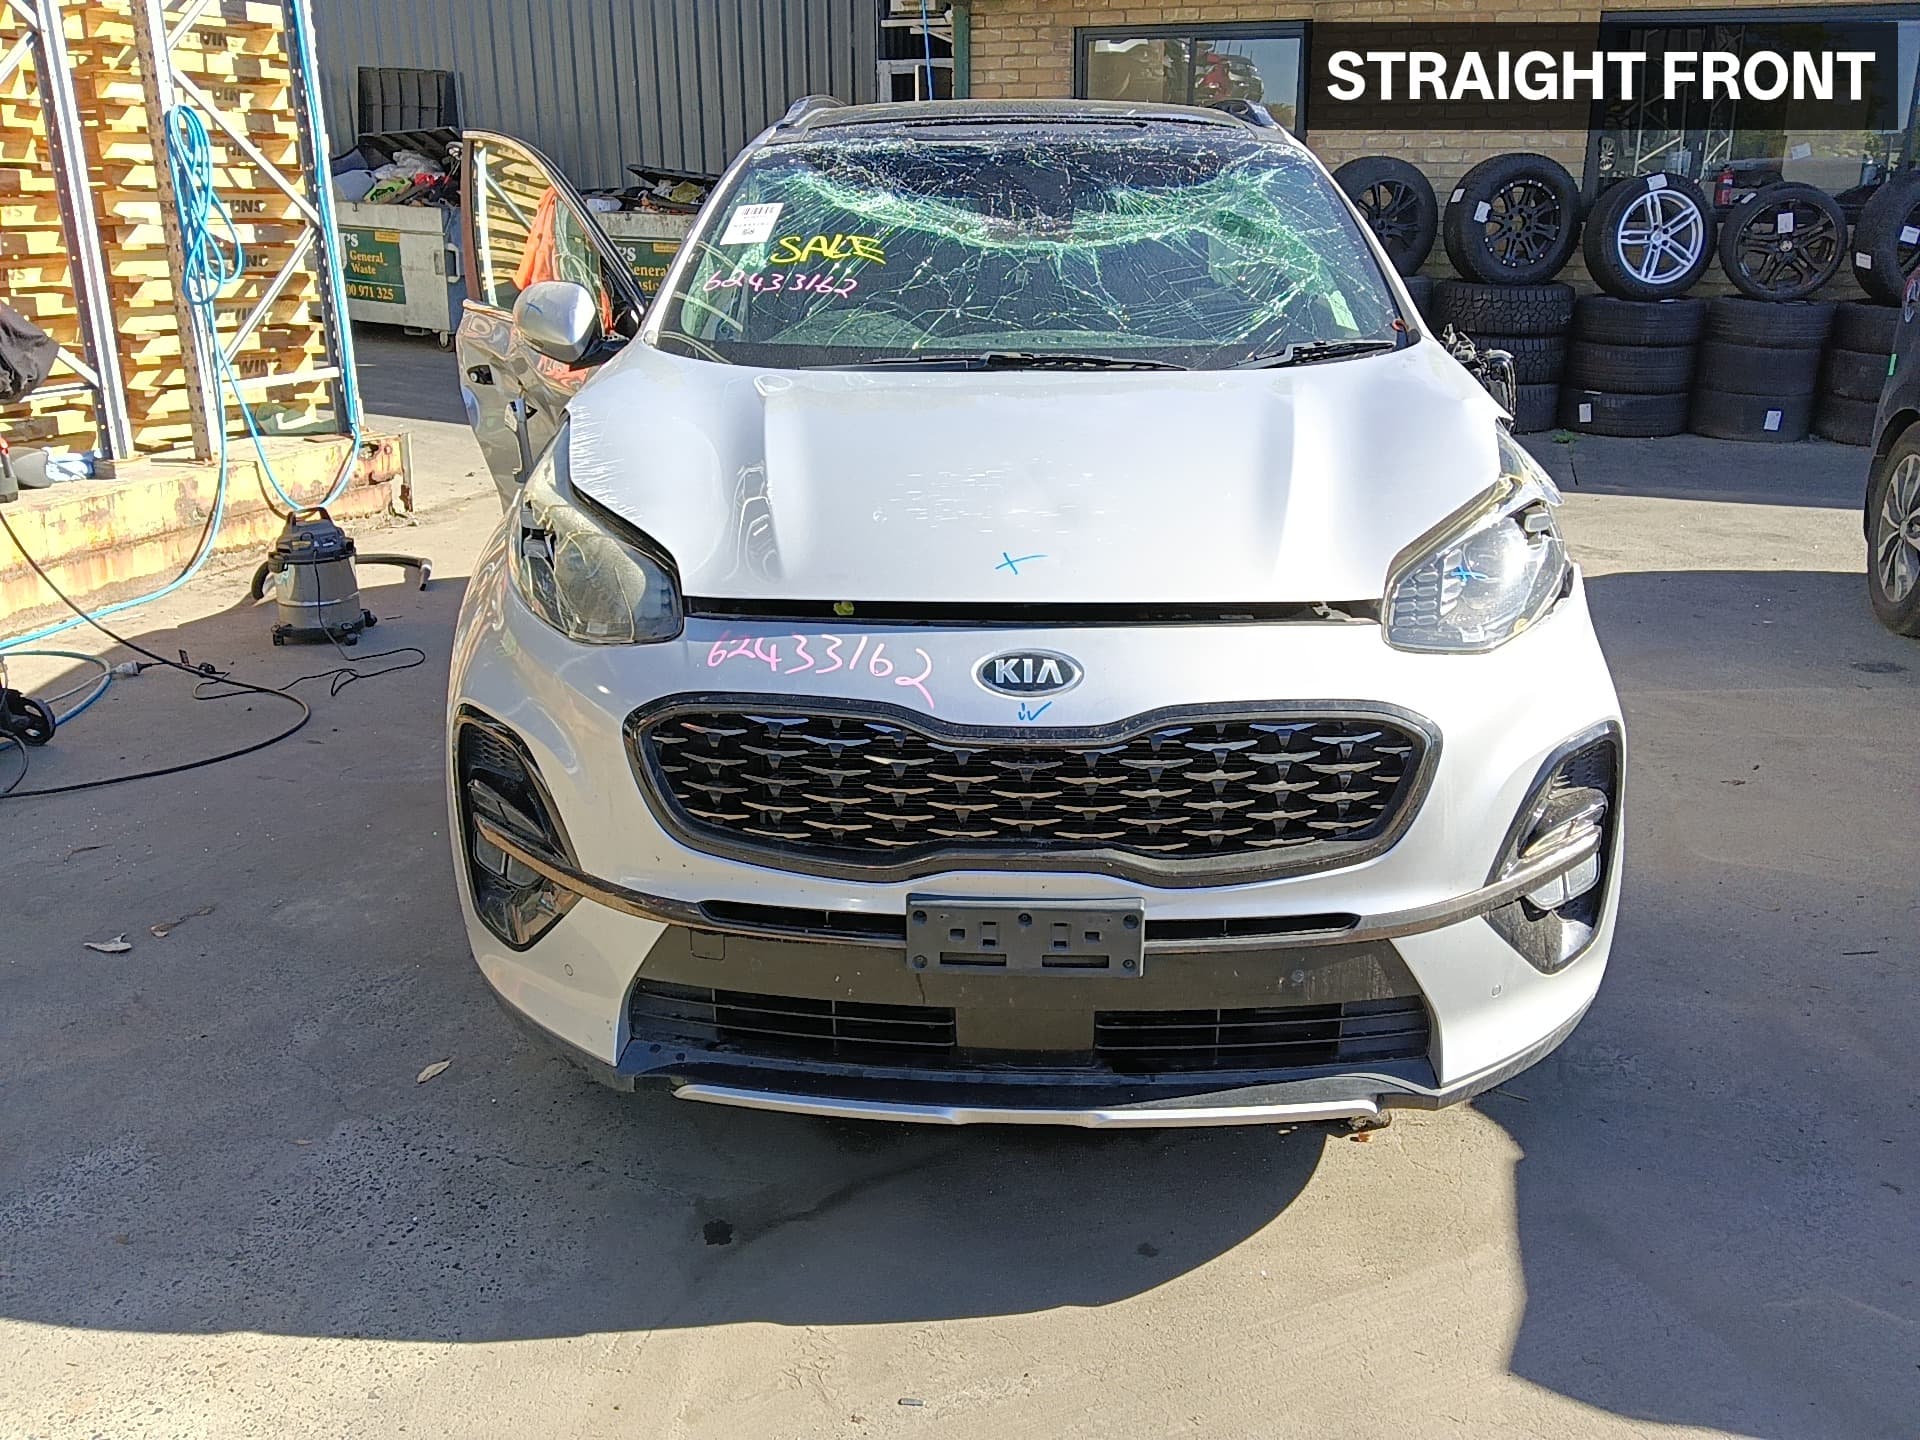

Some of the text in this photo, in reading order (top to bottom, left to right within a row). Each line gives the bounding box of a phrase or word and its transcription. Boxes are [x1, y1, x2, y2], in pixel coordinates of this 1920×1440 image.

[349, 250, 384, 264] General
[770, 233, 886, 265] SALE
[350, 263, 377, 275] Waste
[358, 285, 375, 298] 971
[376, 287, 394, 300] 325
[707, 630, 936, 710] 62433162
[994, 657, 1064, 685] KIA
